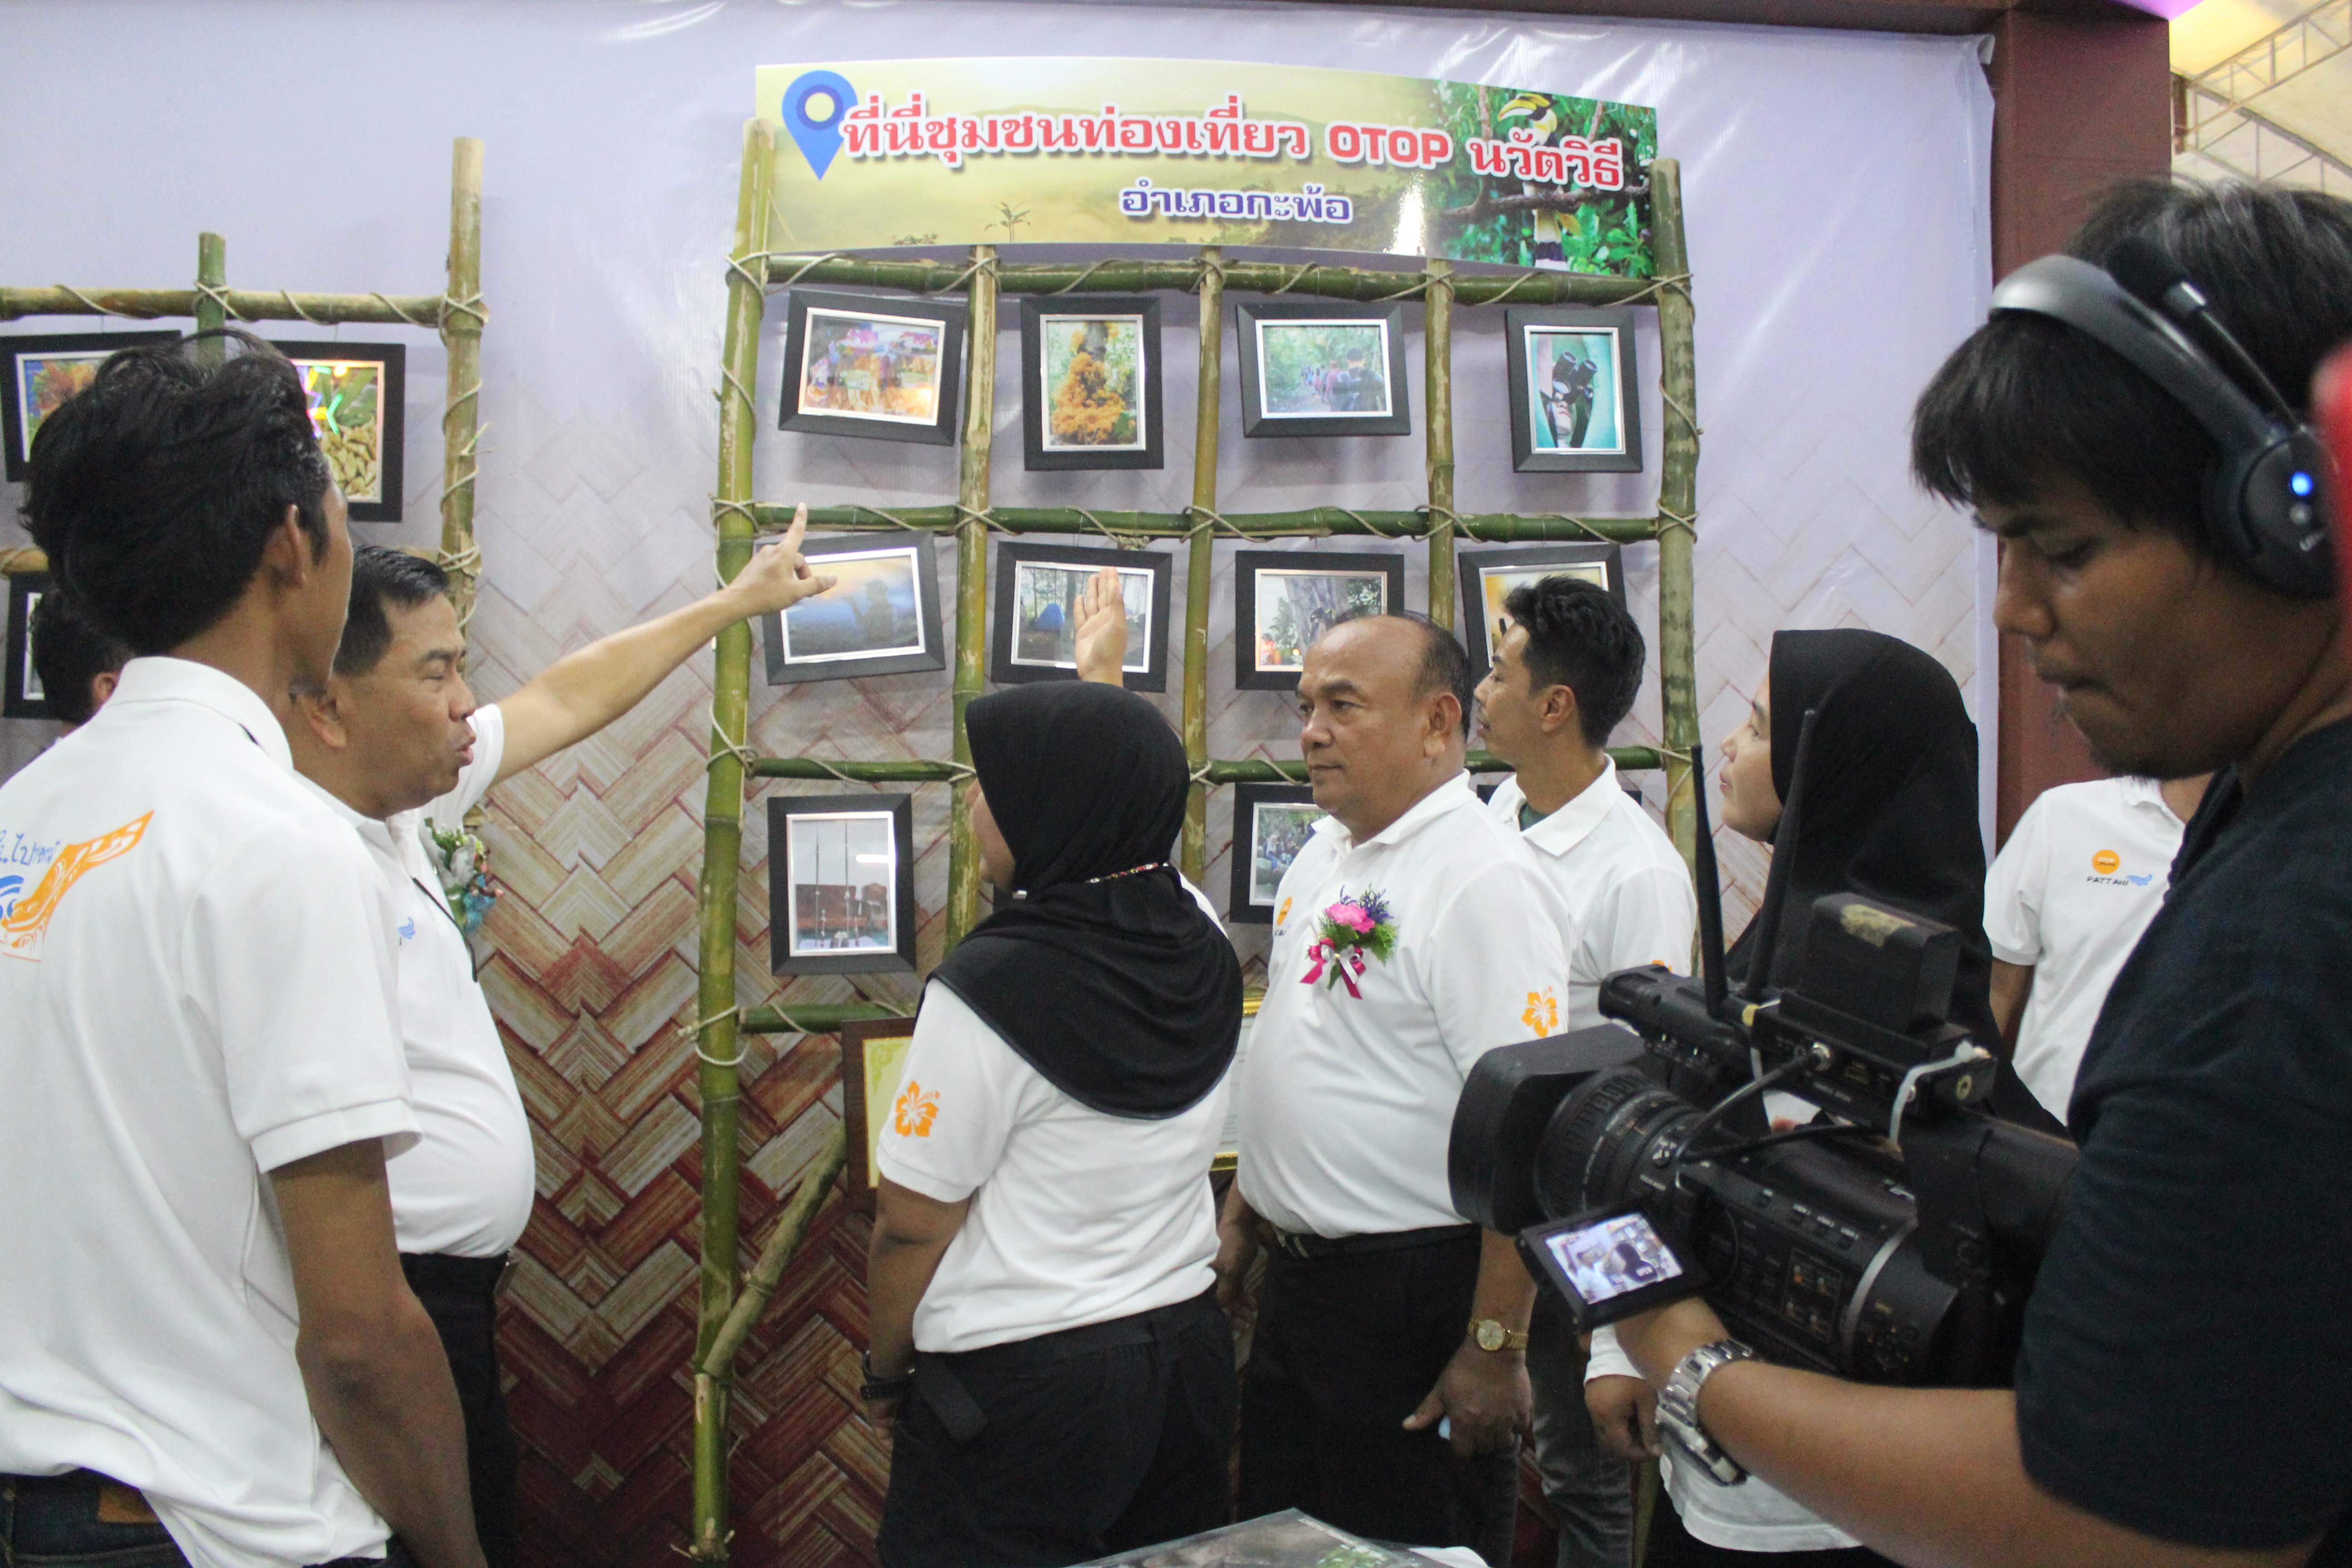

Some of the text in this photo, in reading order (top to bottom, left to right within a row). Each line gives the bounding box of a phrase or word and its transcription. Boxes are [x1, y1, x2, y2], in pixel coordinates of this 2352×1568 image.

[843, 93, 1620, 186] ที่นี่ชุมชนท่องเที่ยว OTOP นวัตวิธี
[1122, 180, 1350, 220] อำเภอกะพ้อ
